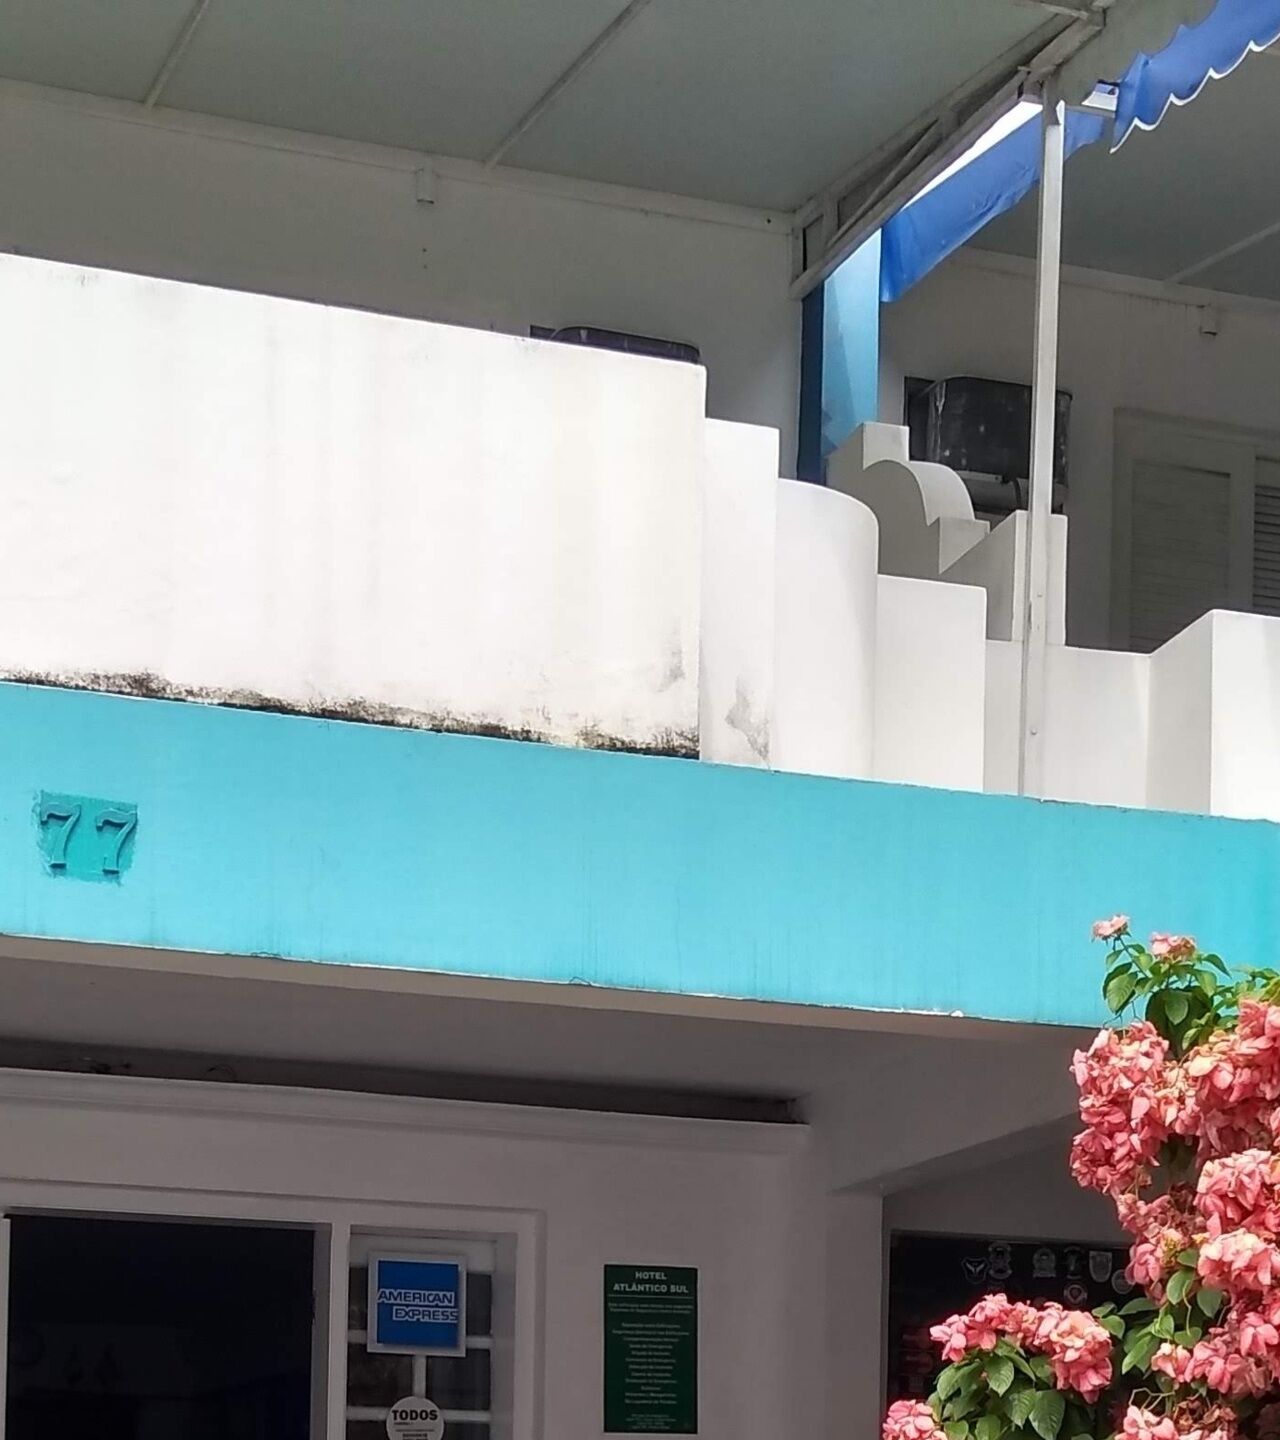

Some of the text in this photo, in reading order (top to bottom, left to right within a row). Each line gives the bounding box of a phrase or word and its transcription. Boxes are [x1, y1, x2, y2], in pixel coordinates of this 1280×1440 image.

[39, 801, 138, 875] 77
[635, 1271, 667, 1280] HOTEL
[670, 1284, 689, 1293] SUL
[376, 1288, 455, 1306] AMERICAN
[392, 1306, 459, 1323] EXPRESS
[391, 1410, 438, 1421] TODOS
